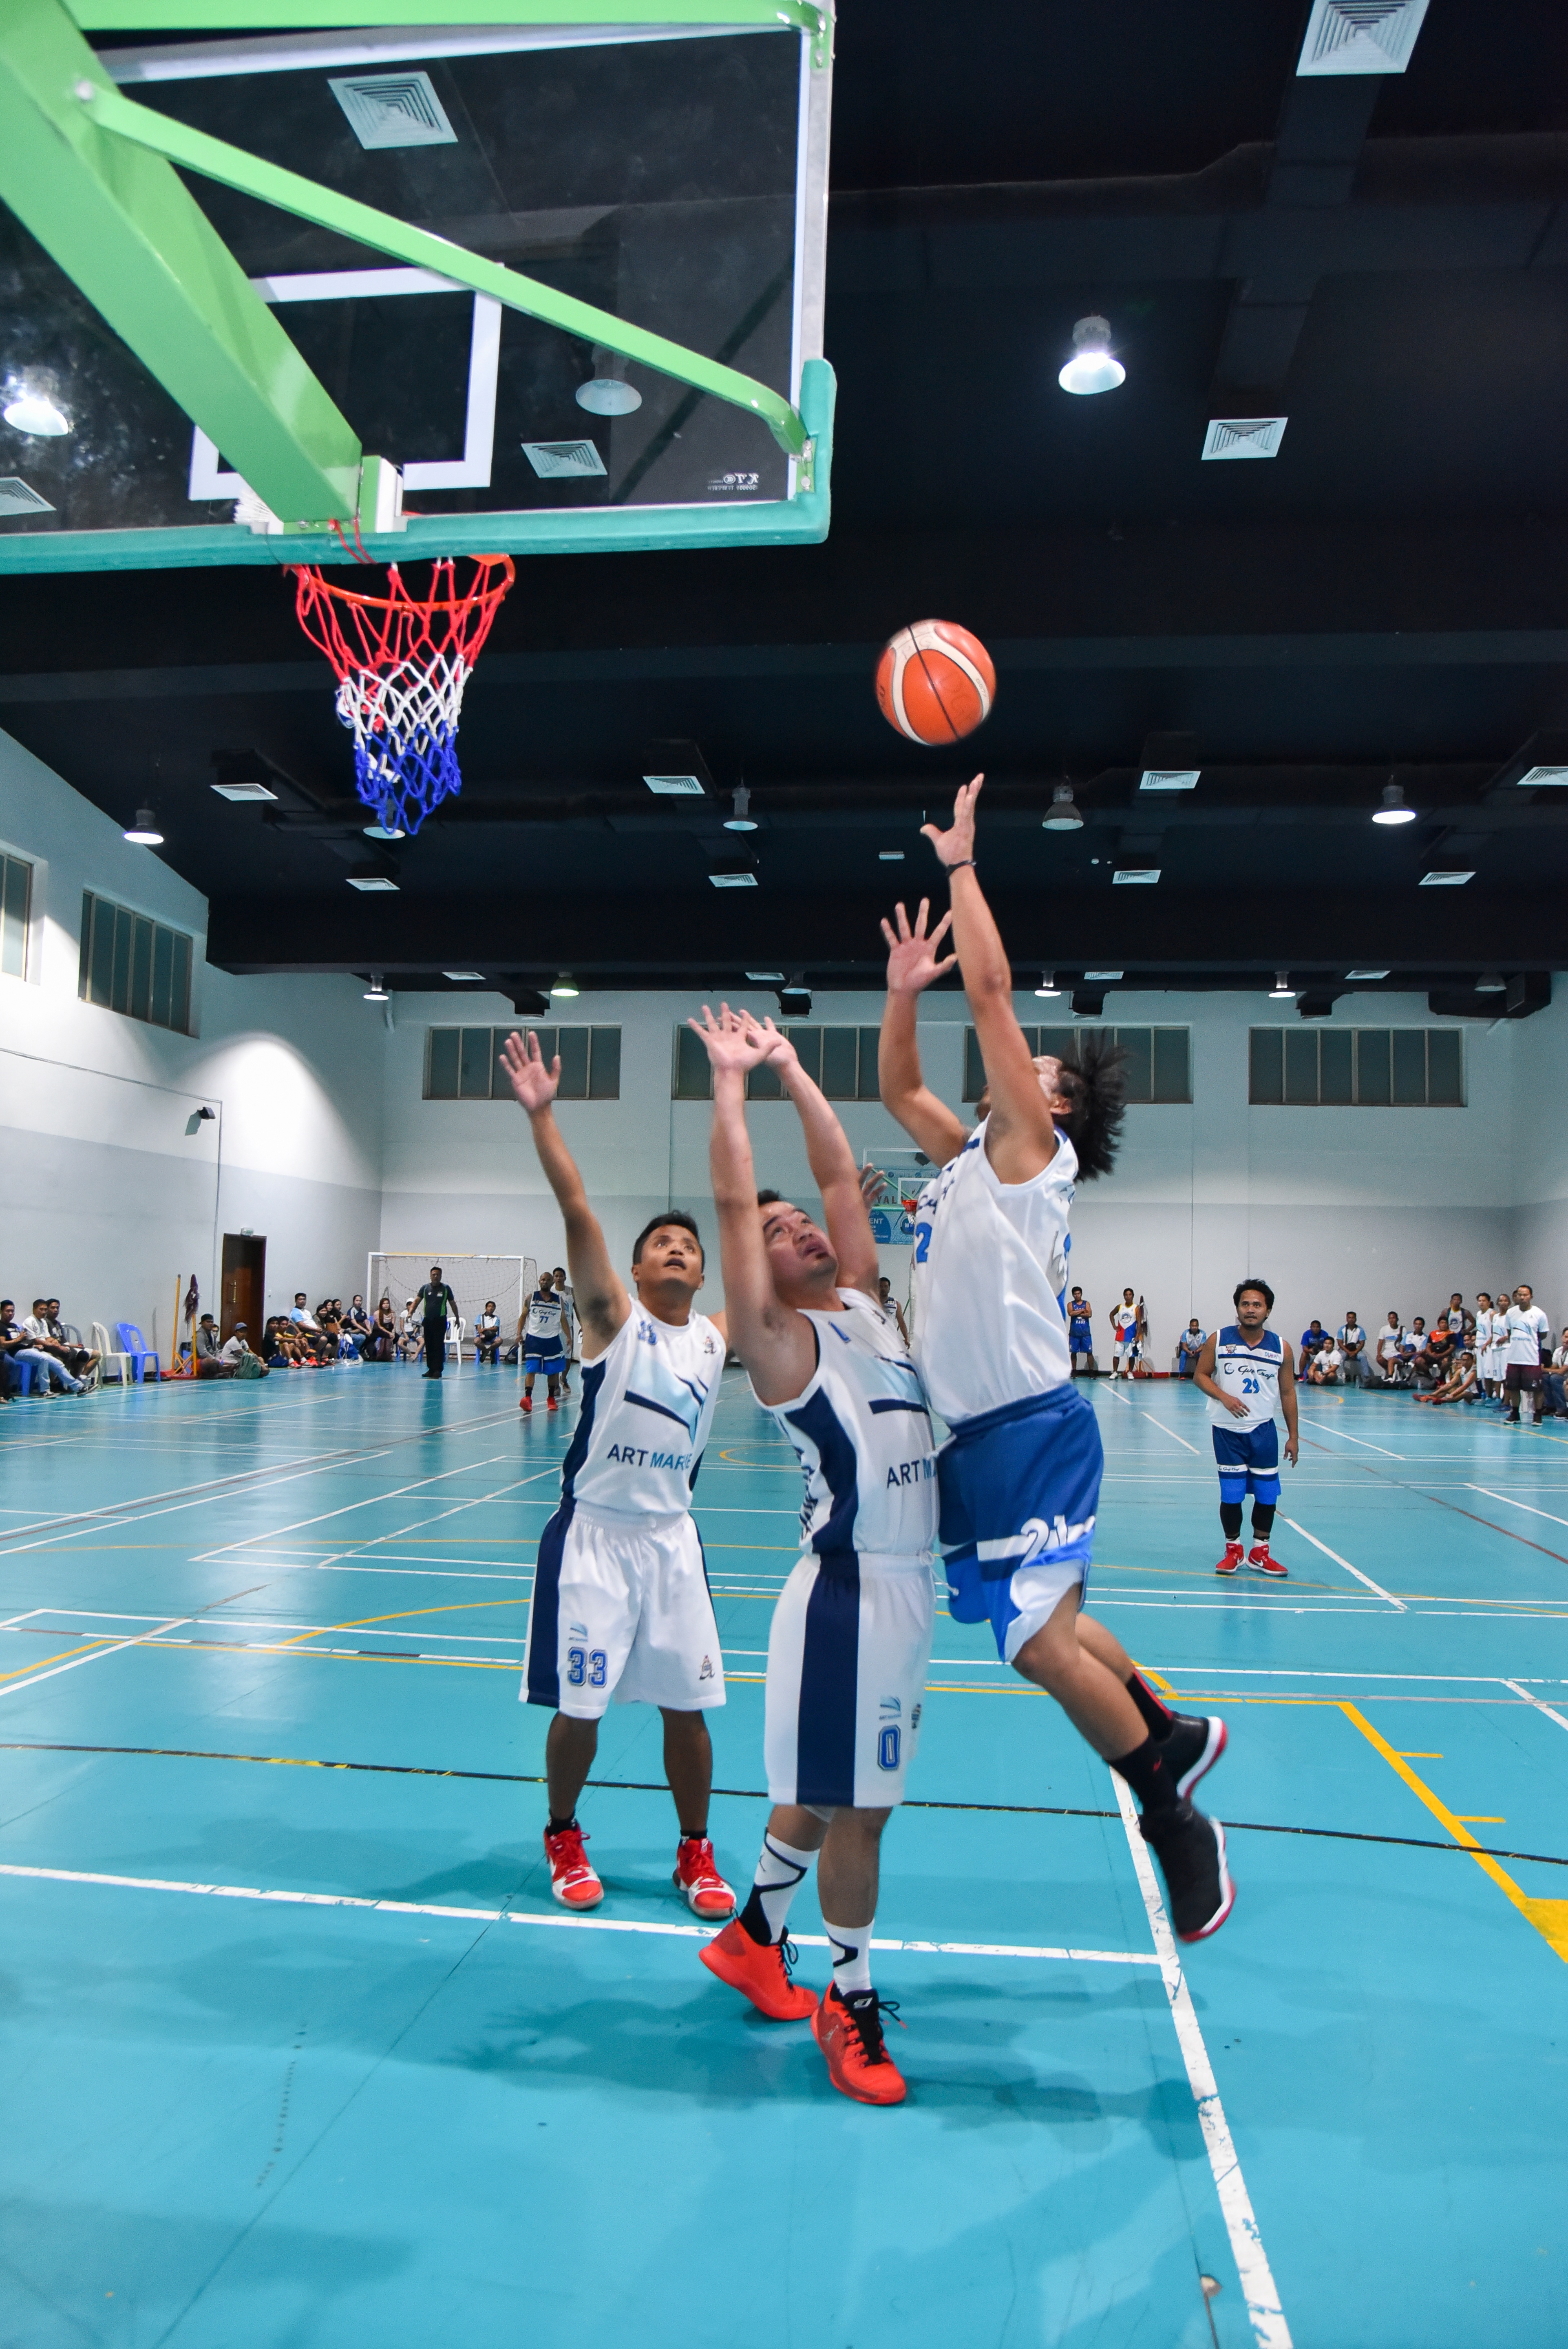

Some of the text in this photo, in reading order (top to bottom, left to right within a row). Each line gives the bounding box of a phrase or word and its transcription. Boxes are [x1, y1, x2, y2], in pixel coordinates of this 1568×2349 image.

[540, 1316, 549, 1324] 77
[607, 1443, 649, 1466] ART
[886, 1459, 920, 1490] ART
[568, 1647, 607, 1688] 33
[877, 1724, 901, 1771] 0
